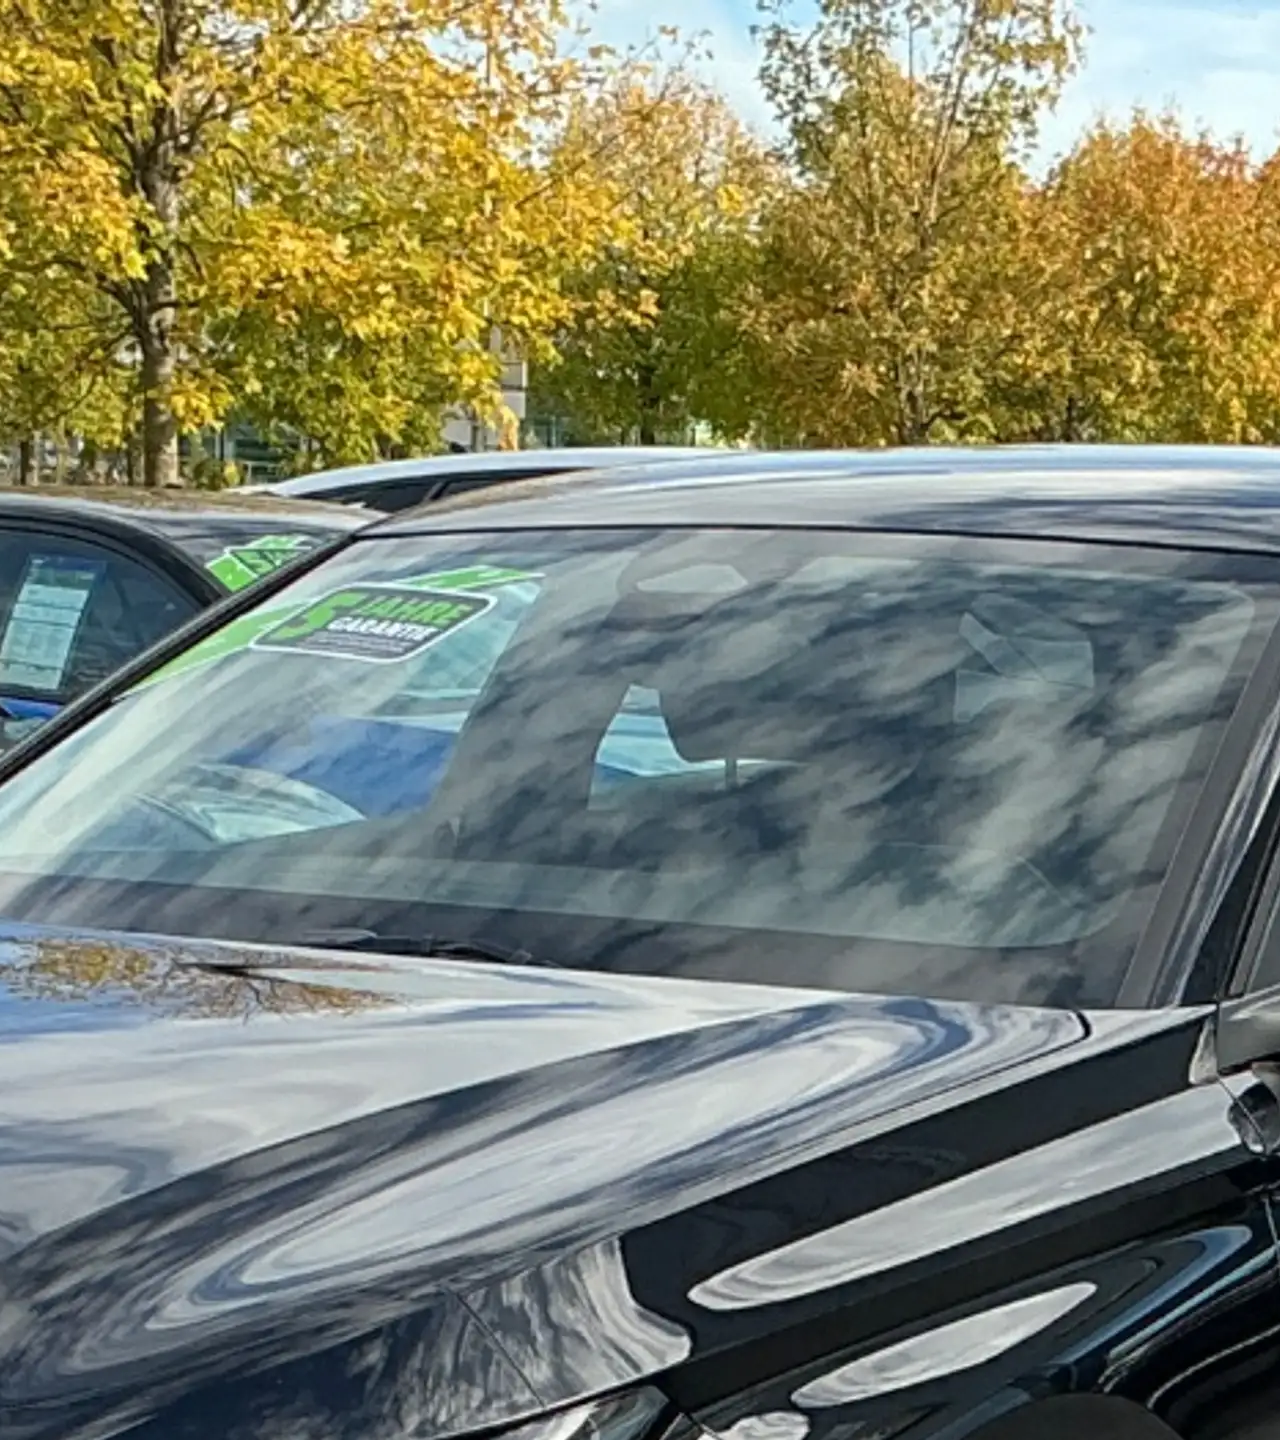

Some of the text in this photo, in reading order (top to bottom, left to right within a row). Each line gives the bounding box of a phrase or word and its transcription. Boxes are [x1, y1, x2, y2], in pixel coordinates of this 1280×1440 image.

[271, 592, 473, 640] 5 JAHRE
[326, 616, 440, 641] GARANTIE
